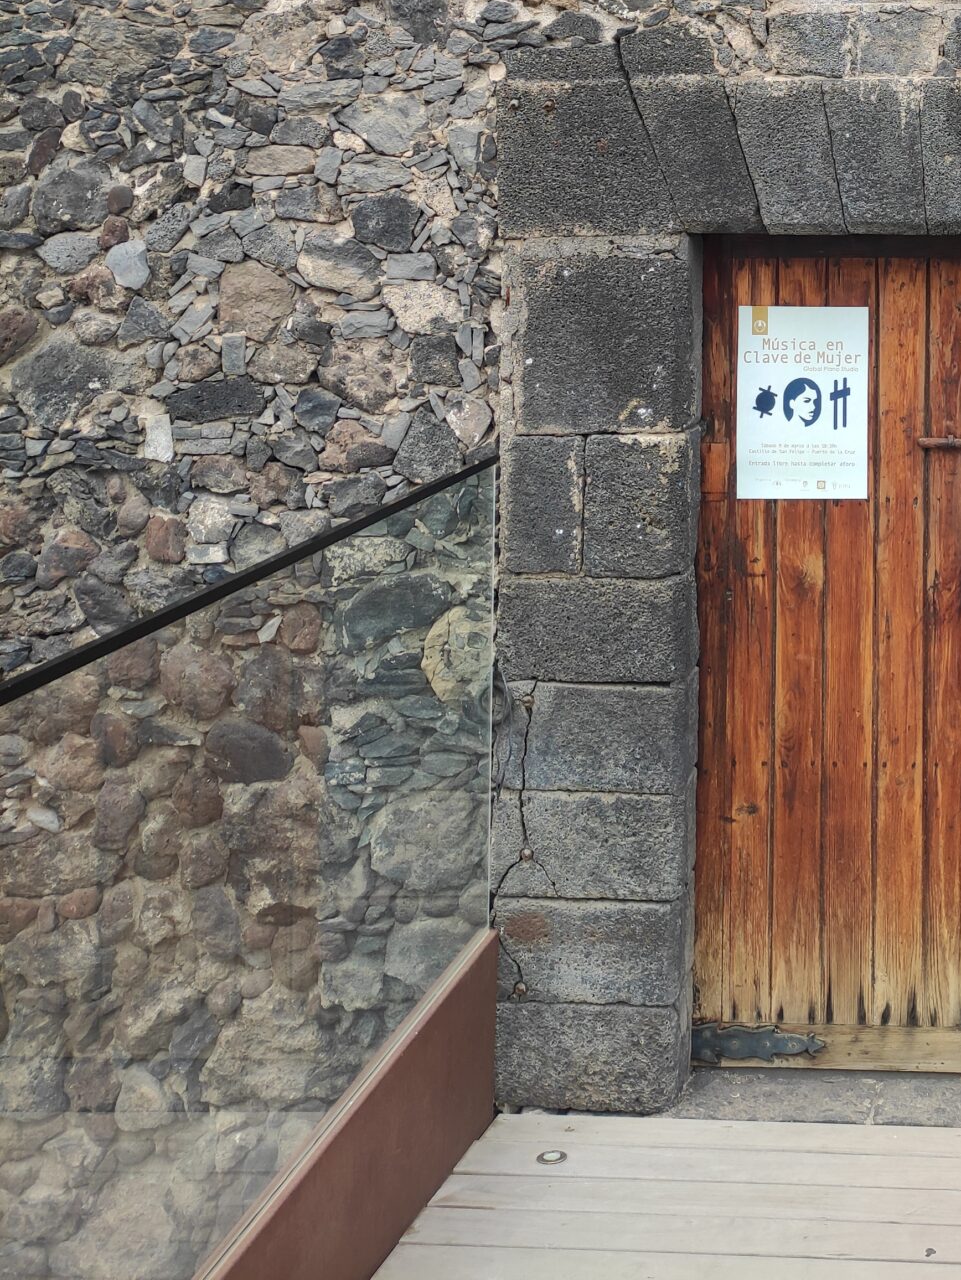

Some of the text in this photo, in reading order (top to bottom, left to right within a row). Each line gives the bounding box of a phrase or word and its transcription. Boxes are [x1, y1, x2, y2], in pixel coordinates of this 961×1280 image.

[762, 337, 844, 351] Música en
[743, 350, 862, 367] Clave de Mujer
